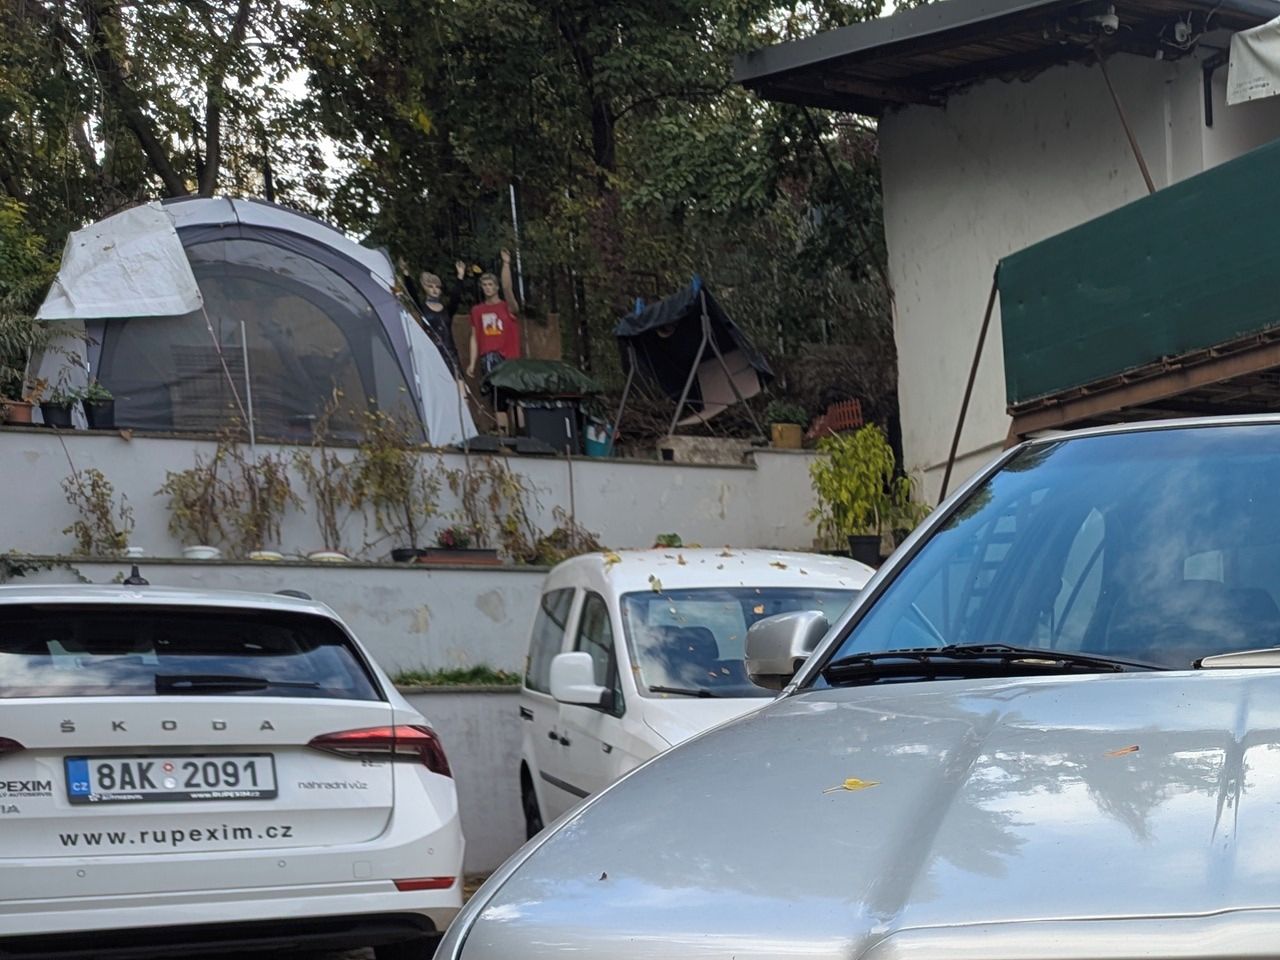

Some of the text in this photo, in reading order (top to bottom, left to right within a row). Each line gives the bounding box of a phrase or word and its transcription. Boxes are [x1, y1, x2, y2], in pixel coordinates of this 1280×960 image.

[60, 719, 275, 733] ŠKODA
[97, 760, 260, 791] 8AK 2091
[72, 782, 89, 791] CZ
[59, 824, 293, 849] www.rupexim.cz
